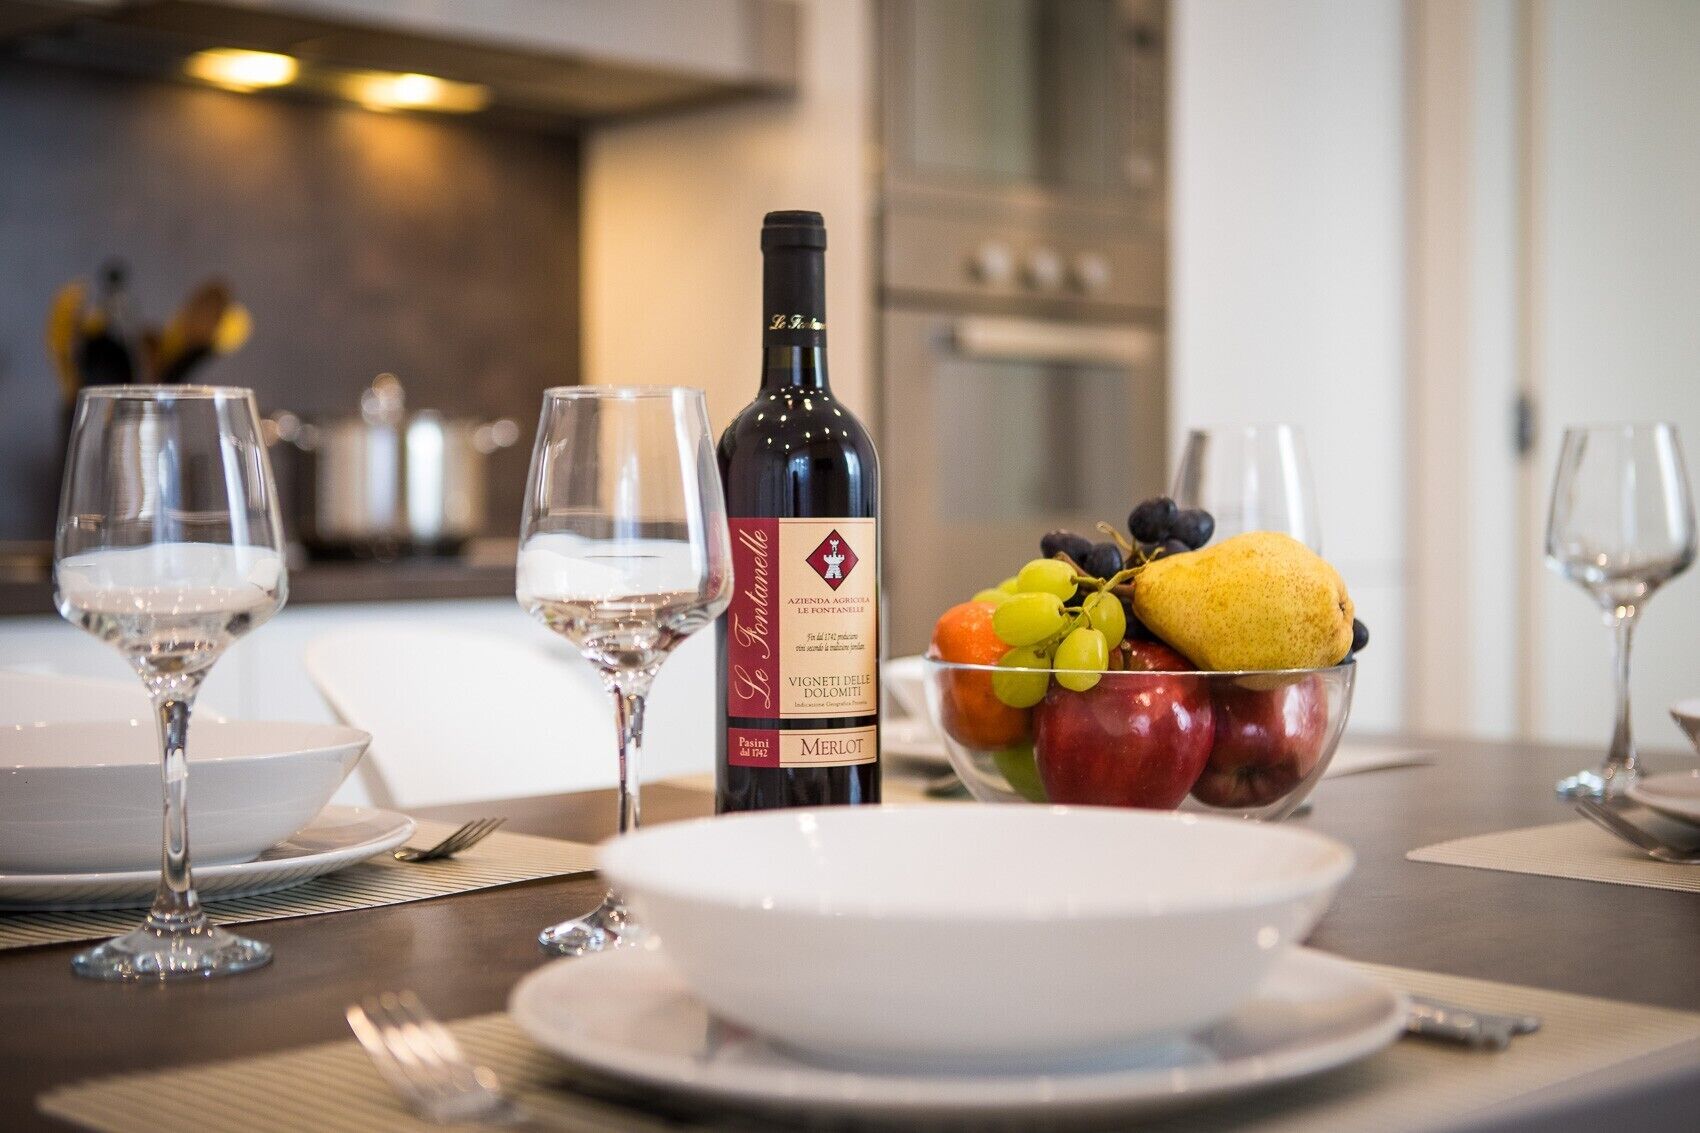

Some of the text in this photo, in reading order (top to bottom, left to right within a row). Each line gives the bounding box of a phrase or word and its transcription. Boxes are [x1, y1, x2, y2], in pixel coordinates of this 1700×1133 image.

[788, 597, 830, 605] AZIENDA
[811, 606, 865, 614] FONTANELLE
[734, 528, 771, 710] Le Fontanelle
[788, 674, 871, 687] VIGNETI DELLE
[804, 686, 862, 698] DOLOMITI
[739, 736, 769, 748] Pasini
[739, 747, 768, 758] dal 1742
